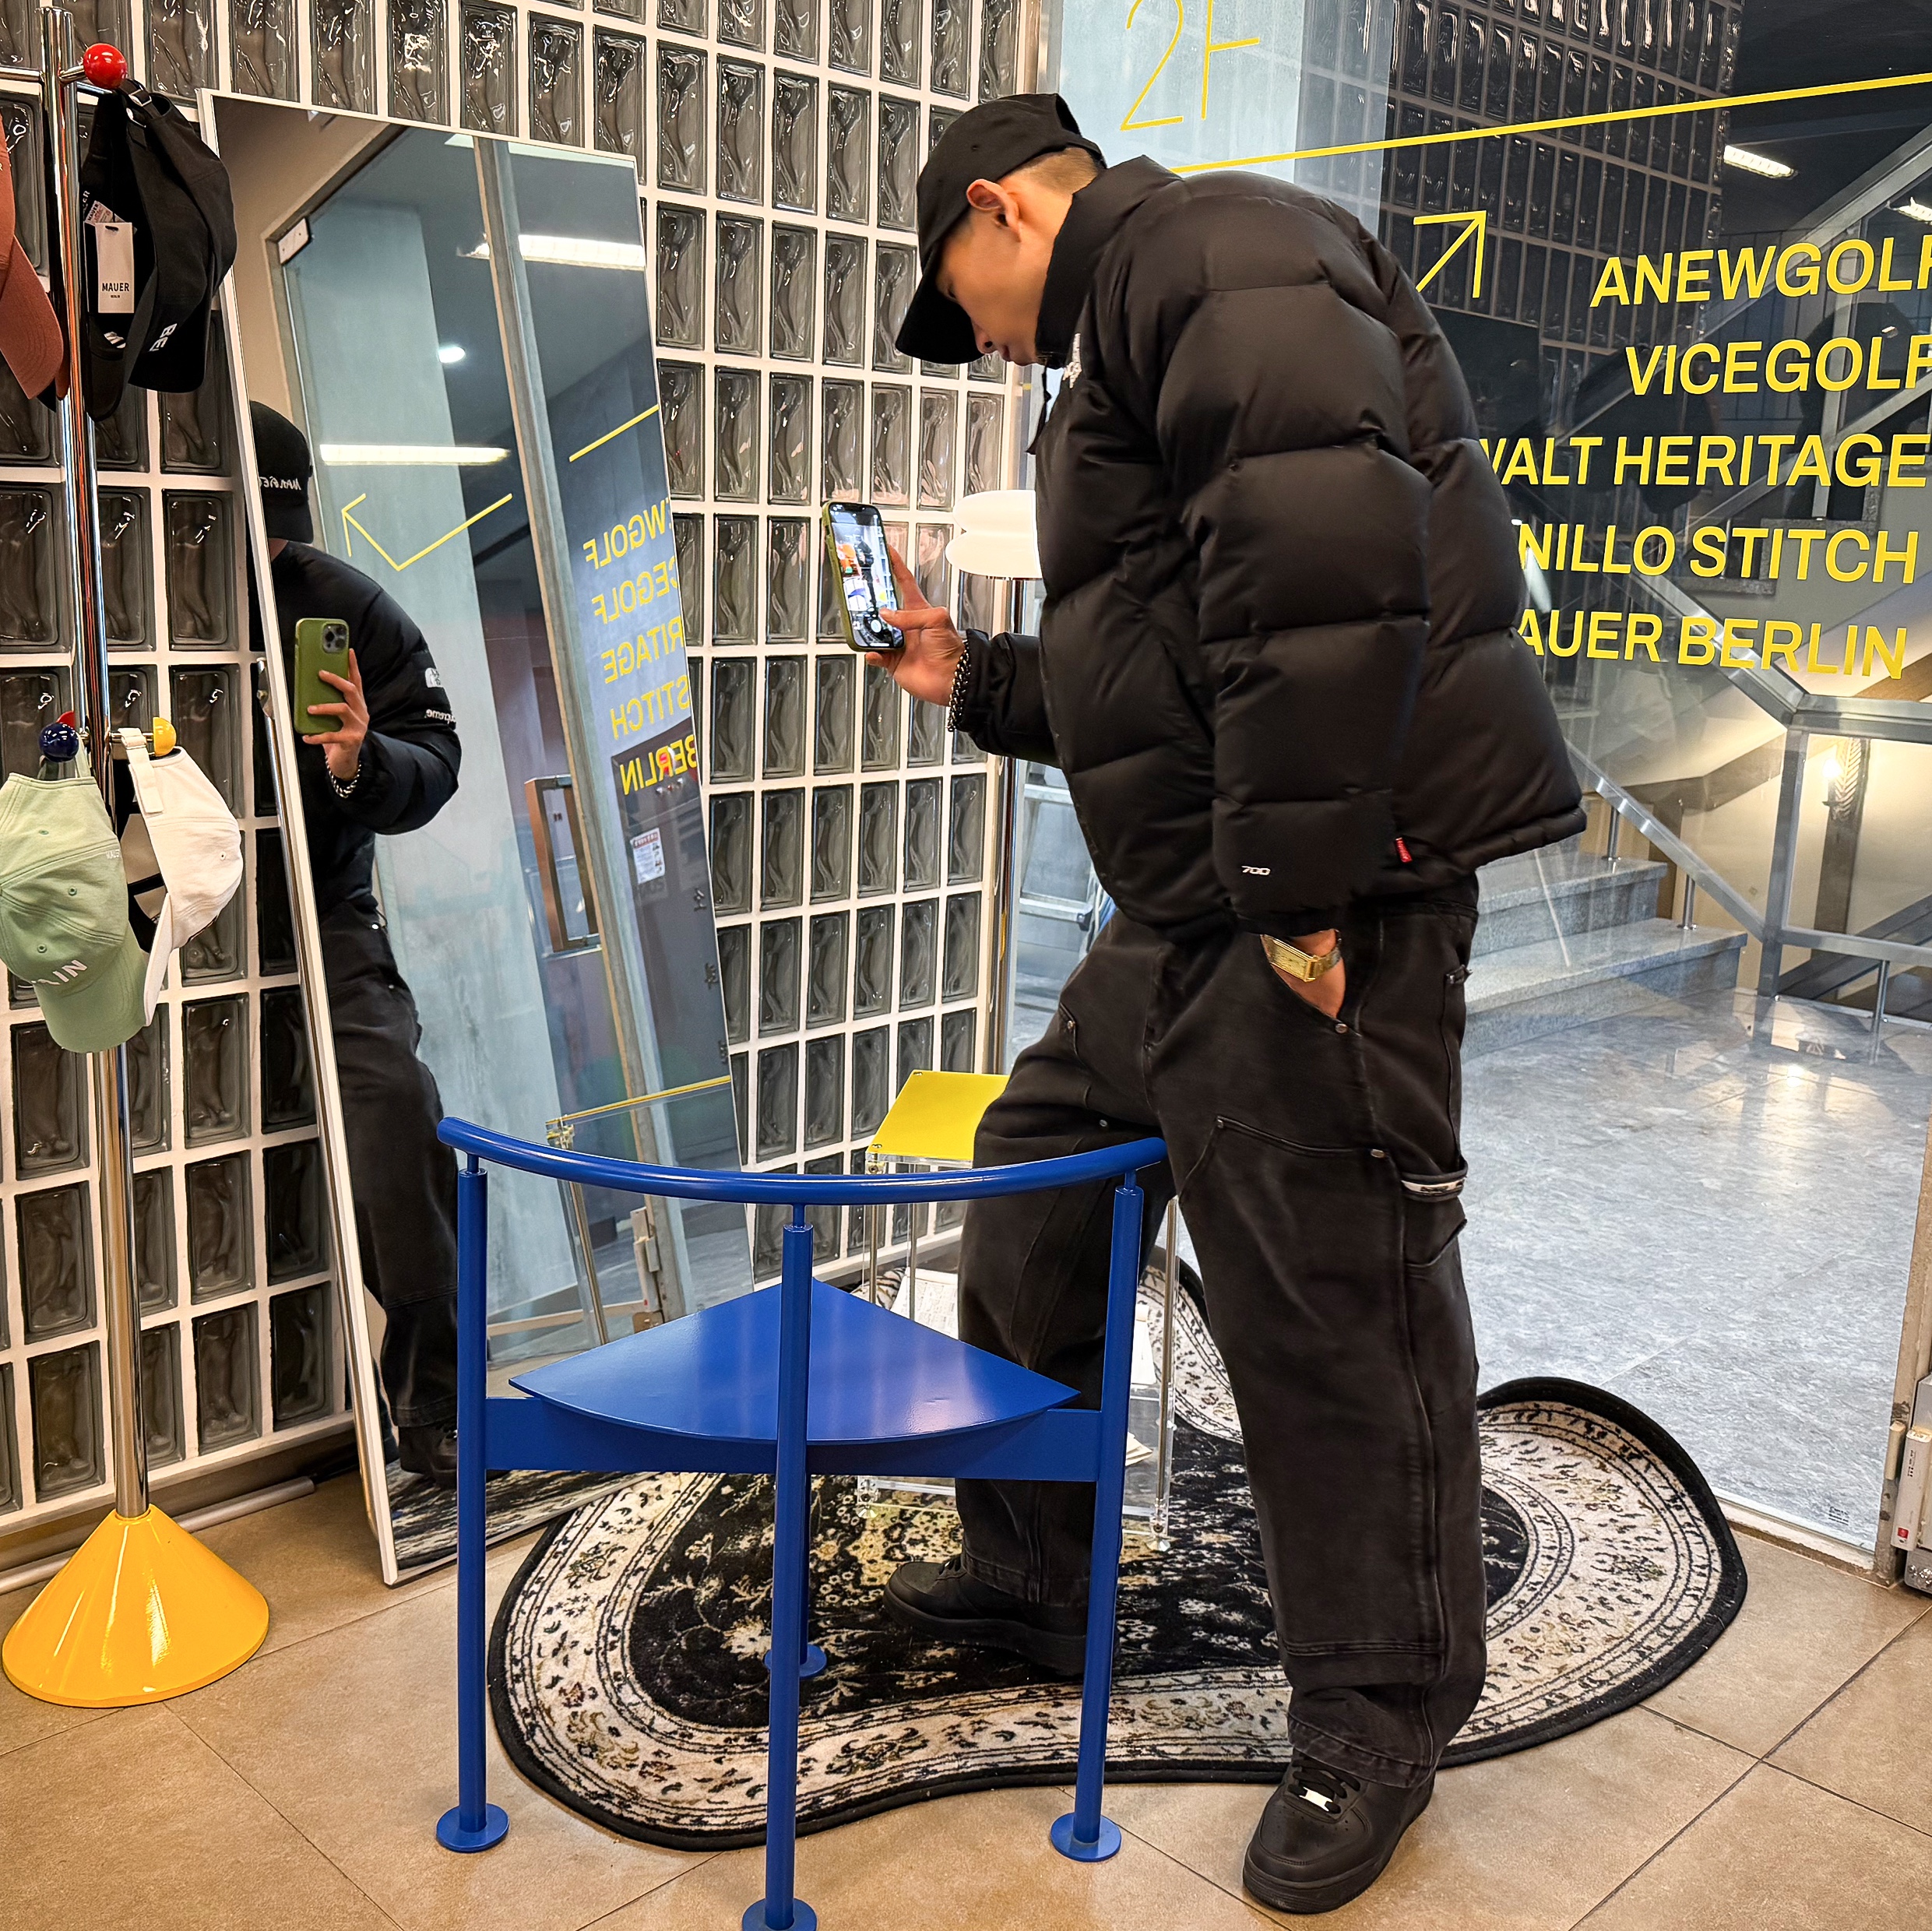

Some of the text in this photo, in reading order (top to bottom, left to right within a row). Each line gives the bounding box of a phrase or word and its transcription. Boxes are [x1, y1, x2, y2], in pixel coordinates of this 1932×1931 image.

[102, 282, 130, 292] MAUER
[1625, 335, 1932, 396] VICEGOLF
[1614, 434, 1931, 488] HERITAGE
[1690, 526, 1919, 584] STITCH
[1678, 616, 1909, 681] BERLIN
[1241, 865, 1271, 875] 700
